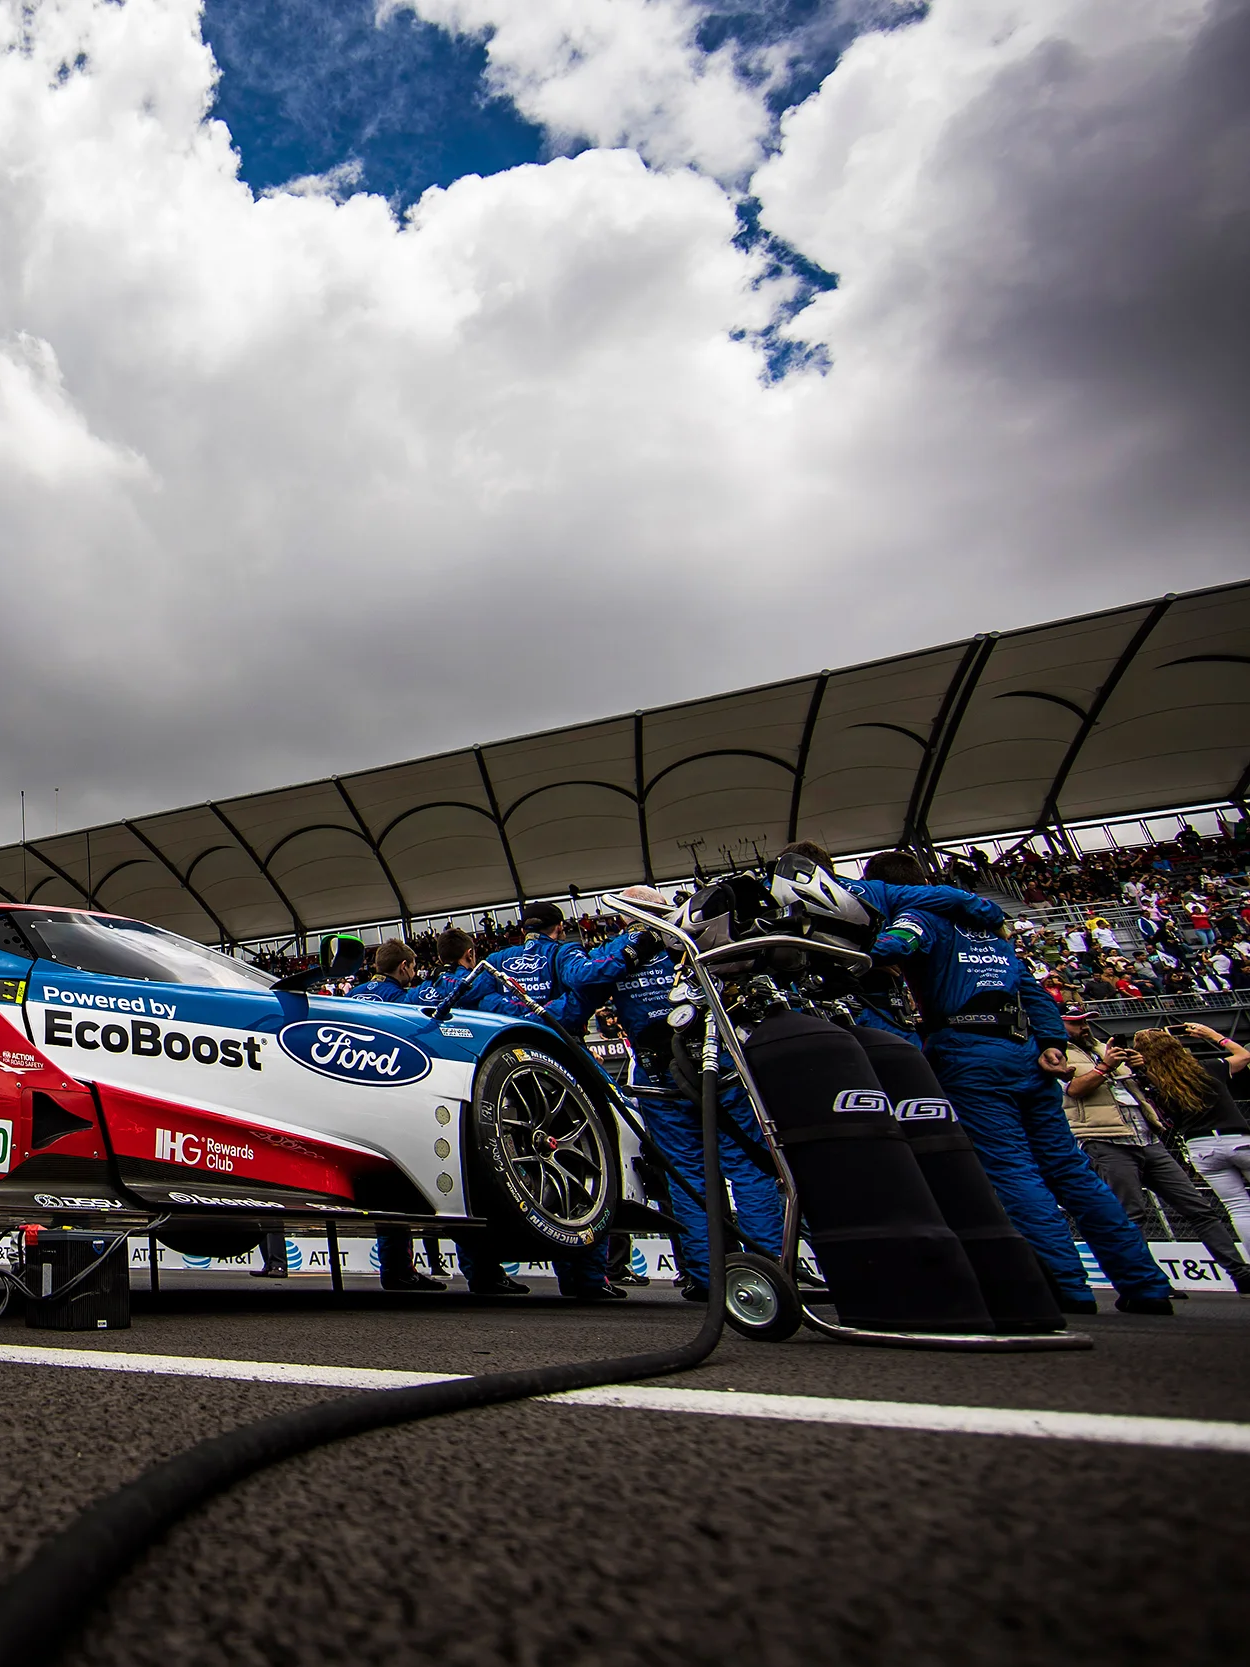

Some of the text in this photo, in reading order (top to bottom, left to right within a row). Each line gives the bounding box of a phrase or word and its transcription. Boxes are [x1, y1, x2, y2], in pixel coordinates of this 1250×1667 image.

[510, 956, 540, 970] Ford
[43, 986, 177, 1020] Powered by
[12, 1053, 34, 1061] ACTION
[311, 1026, 402, 1076] Ford
[608, 1043, 624, 1054] 88
[530, 1052, 574, 1081] MICHELIN
[207, 1138, 254, 1160] Rewards
[206, 1154, 233, 1172] Club
[529, 1215, 579, 1244] MICHELIN
[132, 1248, 165, 1261] ATT
[309, 1251, 348, 1266] ATT
[1157, 1259, 1222, 1281] T&T
